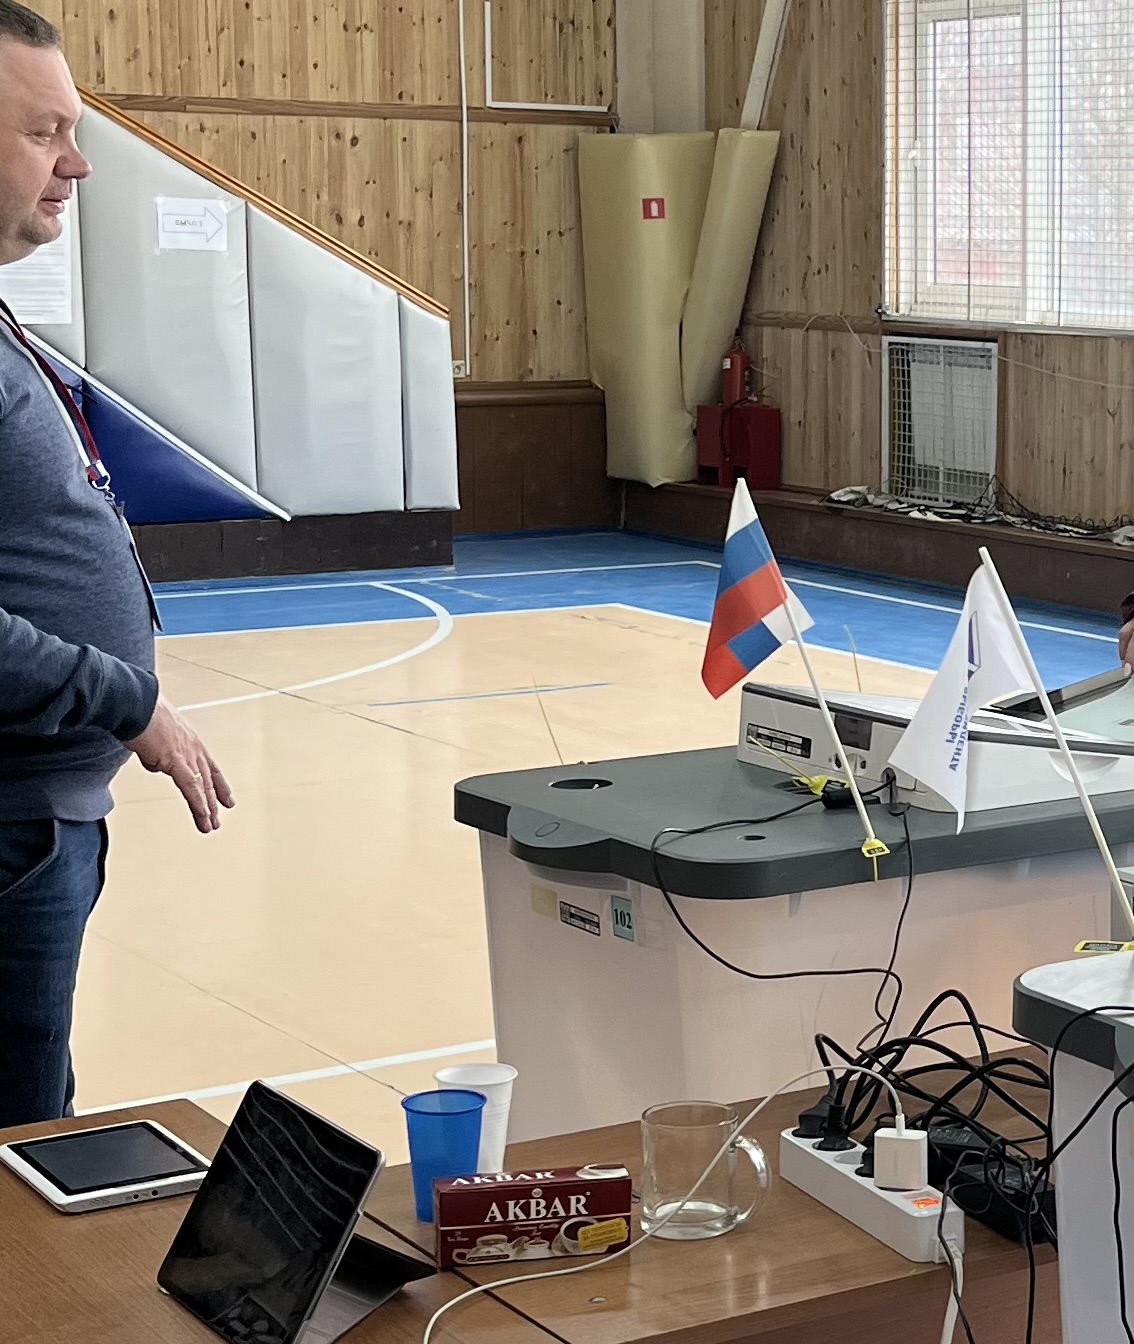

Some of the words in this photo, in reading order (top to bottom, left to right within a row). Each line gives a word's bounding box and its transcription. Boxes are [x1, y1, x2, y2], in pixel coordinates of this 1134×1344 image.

[614, 908, 632, 929] 102
[451, 1170, 556, 1186] AKBAR
[484, 1194, 589, 1223] AKBAR
